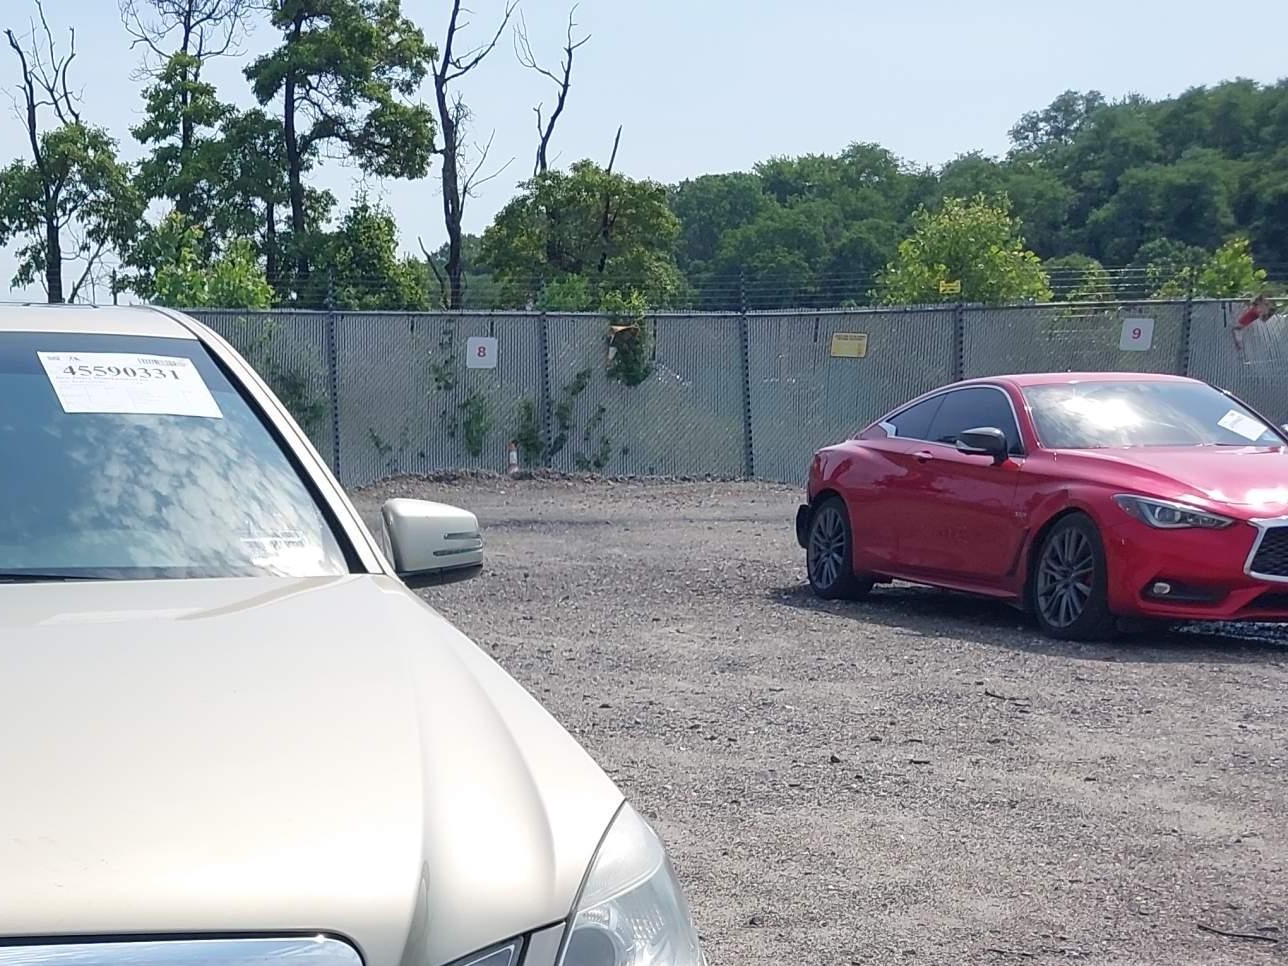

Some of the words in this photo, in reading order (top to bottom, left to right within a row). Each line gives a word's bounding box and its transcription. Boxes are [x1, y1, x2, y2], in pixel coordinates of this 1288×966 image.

[1131, 327, 1142, 340] 9
[477, 346, 487, 358] 8
[63, 364, 181, 381] 45590331
